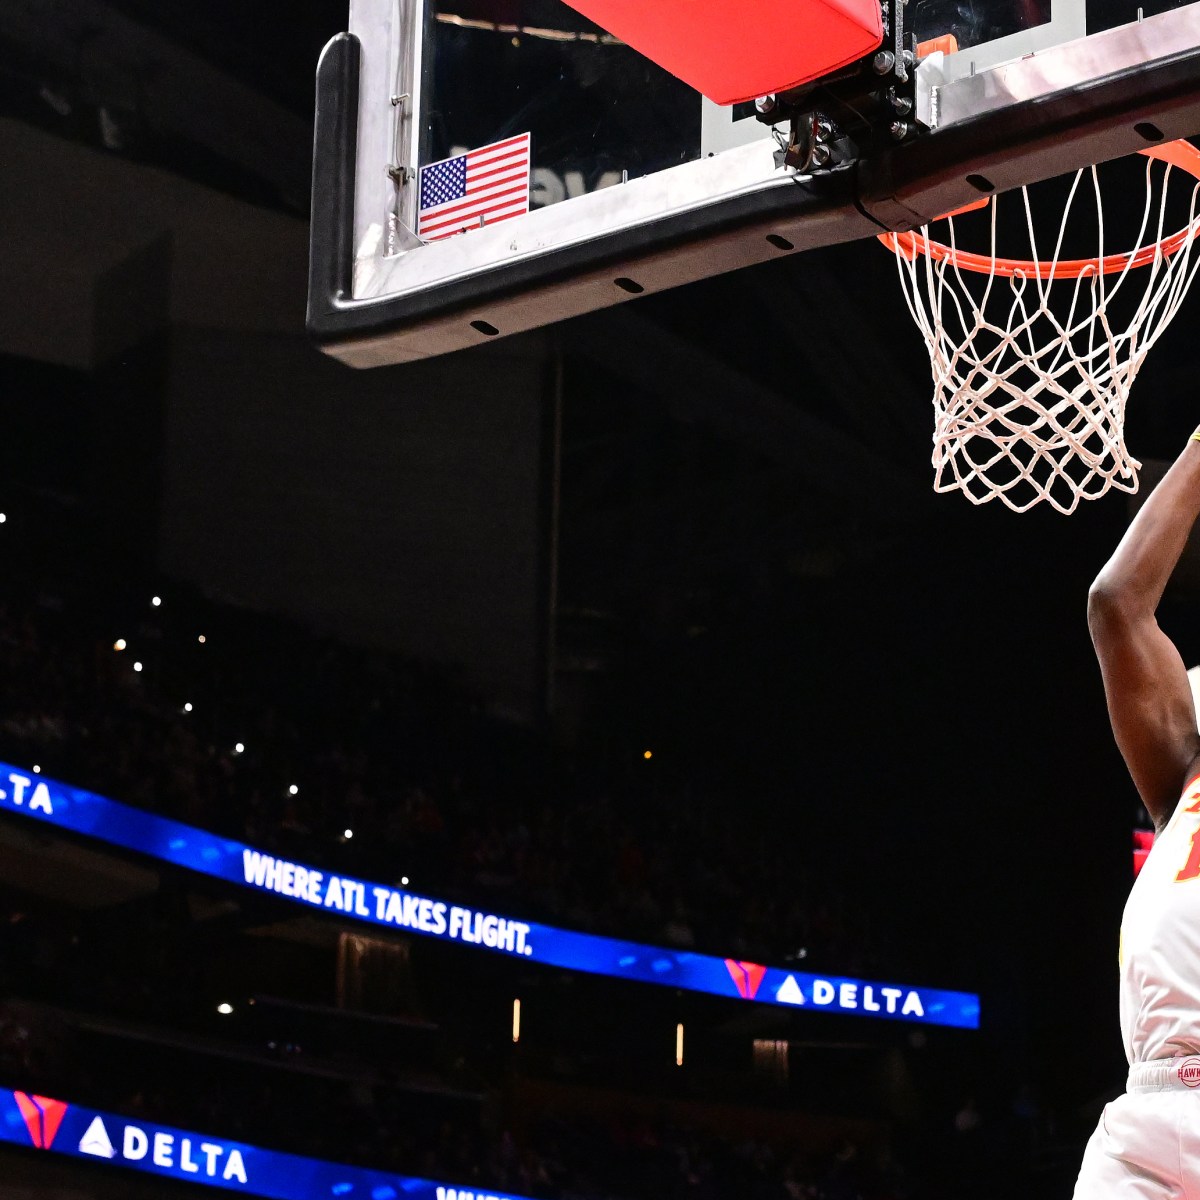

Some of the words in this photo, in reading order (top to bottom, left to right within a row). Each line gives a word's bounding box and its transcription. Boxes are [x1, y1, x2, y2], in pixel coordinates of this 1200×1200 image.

[243, 849, 323, 904] WHERE
[324, 876, 369, 916] ATL
[373, 887, 447, 935] TAKES
[449, 906, 533, 956] FLIGHT.
[813, 979, 924, 1017] DELTA
[123, 1125, 247, 1183] DELTA
